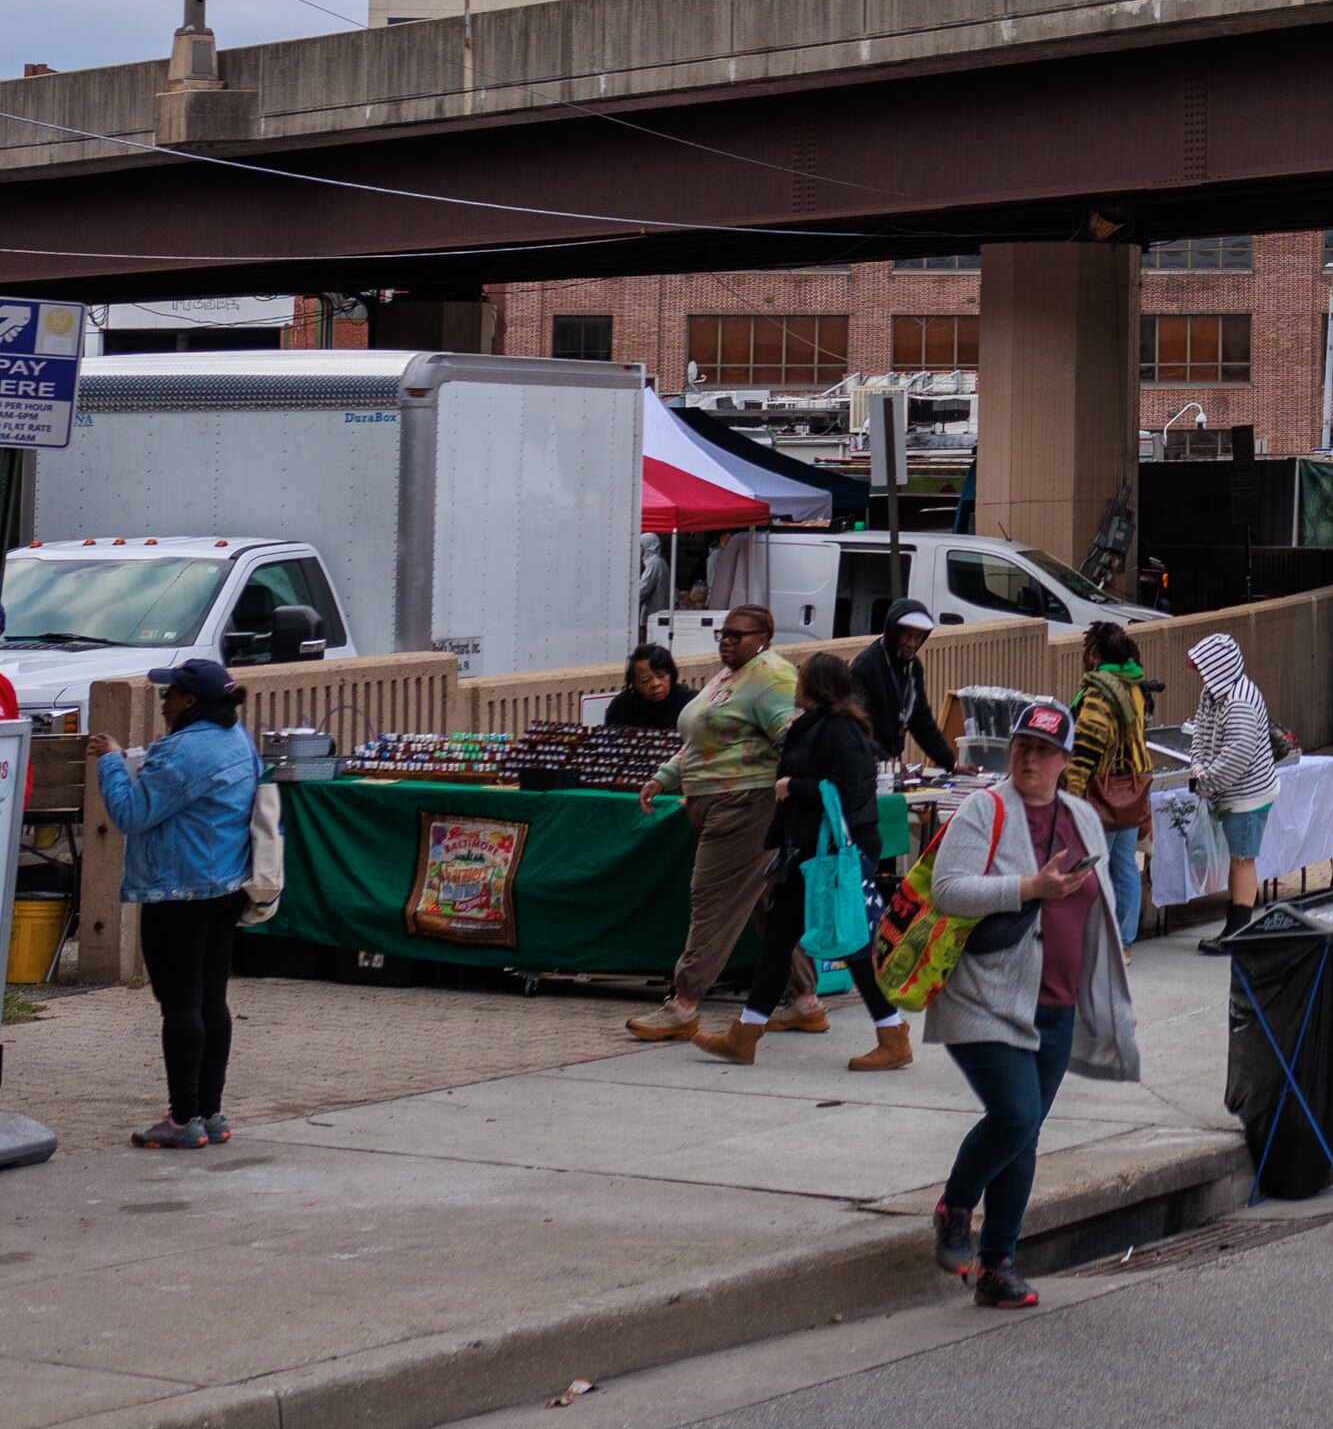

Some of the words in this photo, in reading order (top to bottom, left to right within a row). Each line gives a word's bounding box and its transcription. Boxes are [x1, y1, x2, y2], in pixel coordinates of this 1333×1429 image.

[0, 379, 56, 398] ERE
[4, 401, 23, 411] PER
[25, 403, 54, 412] HOUR
[344, 412, 398, 424] DuraBox
[3, 422, 26, 431] FLAT
[28, 424, 52, 433] RATE
[0, 433, 36, 442] M-4AM
[444, 837, 499, 856] BALTIMORE
